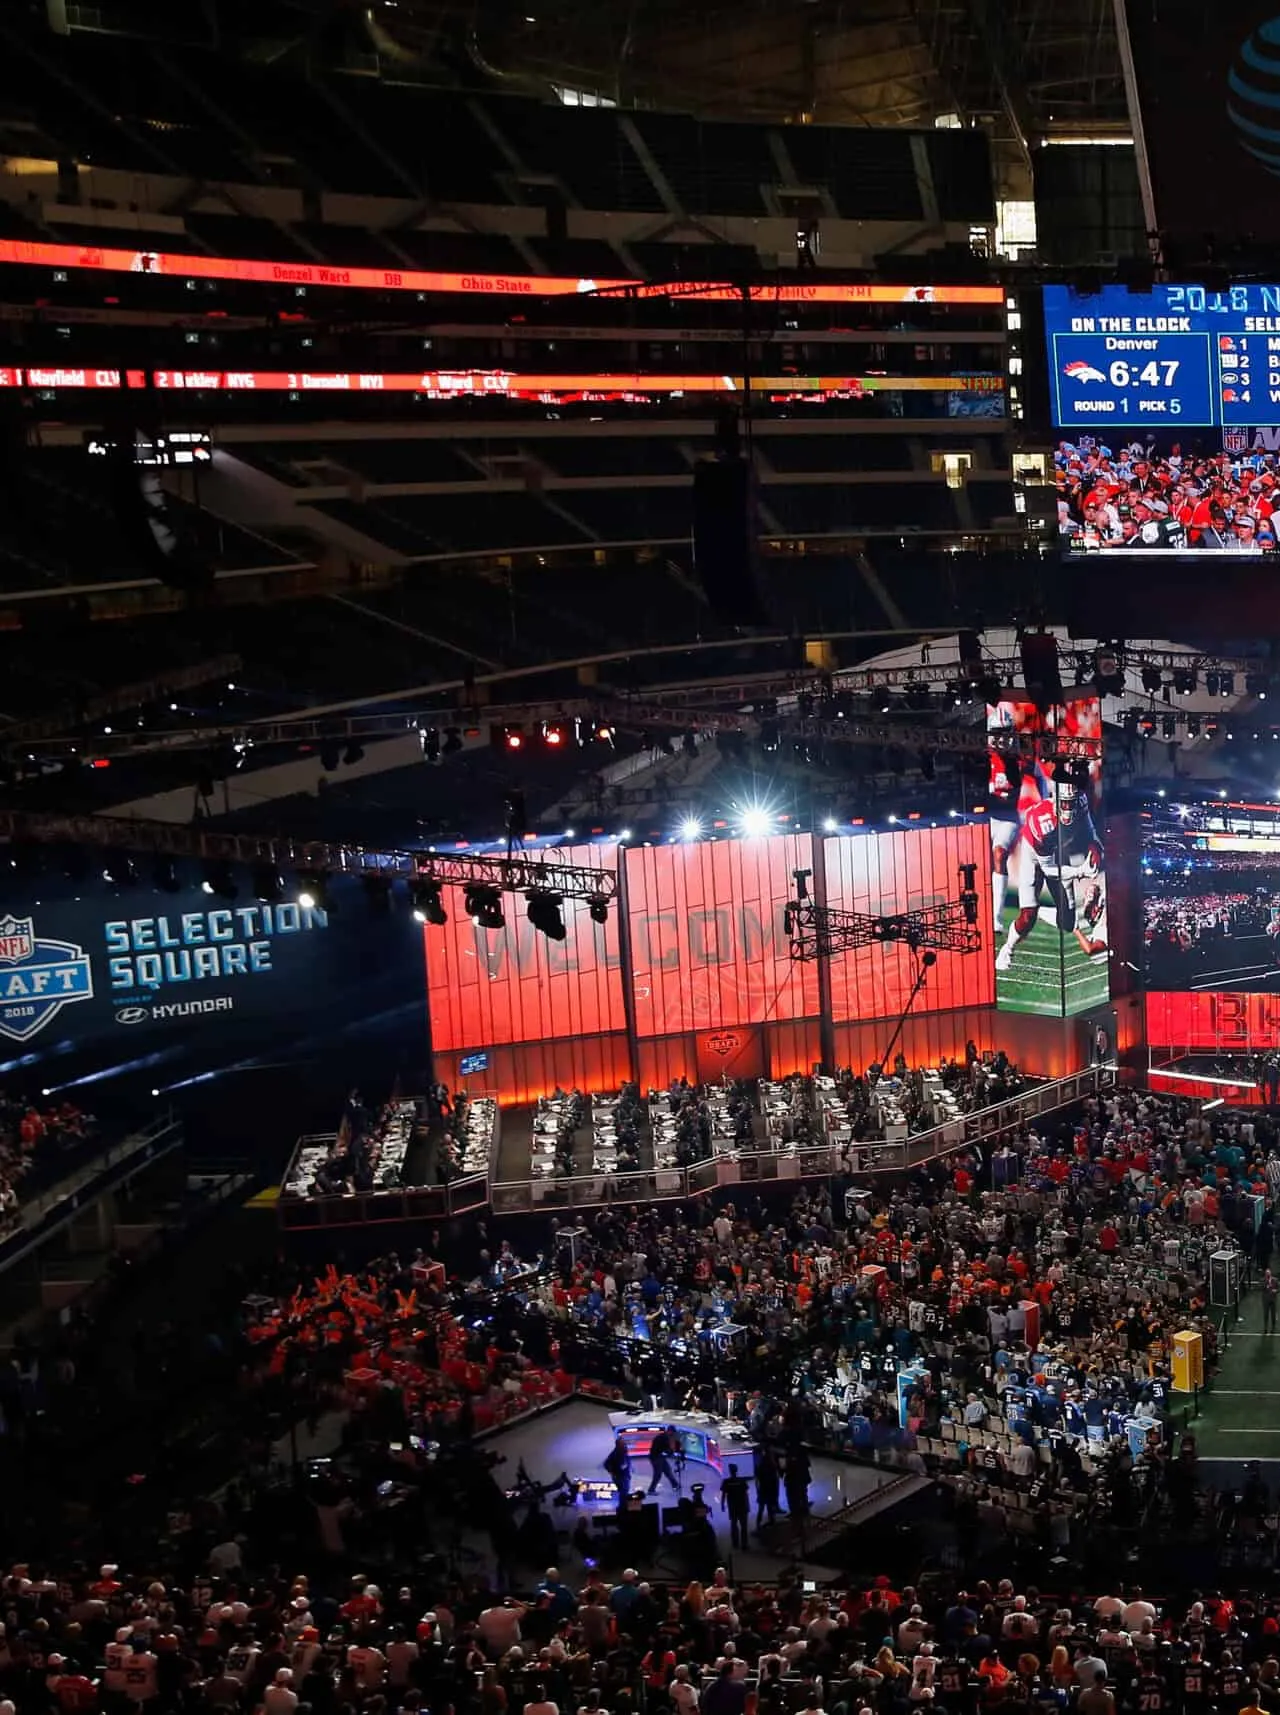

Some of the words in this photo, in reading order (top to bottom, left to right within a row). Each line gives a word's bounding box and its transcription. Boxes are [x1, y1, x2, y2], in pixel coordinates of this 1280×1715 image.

[273, 266, 313, 281] Denzel
[319, 269, 350, 283] Ward
[384, 273, 402, 286] DB
[461, 278, 493, 290] Ohio
[496, 279, 532, 292] State
[1167, 286, 1248, 313] 2018
[1071, 317, 1095, 332] ON
[1099, 317, 1131, 332] THE
[1136, 317, 1191, 332] CLOCK
[1106, 337, 1158, 350] Denver
[1240, 338, 1247, 351] 1
[1239, 356, 1250, 368] 2
[30, 370, 84, 387] Mayfield
[158, 373, 168, 387] 2
[227, 373, 255, 388] NYG
[288, 374, 297, 388] 3
[437, 375, 473, 390] Ward
[1109, 360, 1180, 387] 6:47
[1240, 373, 1251, 386] 3
[1241, 390, 1251, 403] 4
[1074, 400, 1115, 412] ROUND
[1120, 398, 1129, 414] 1
[1139, 400, 1167, 412] PICK
[1169, 398, 1182, 415] 5
[105, 902, 329, 953] SELECTION
[109, 940, 273, 990] SQUARE
[4, 1006, 36, 1018] 2018
[152, 996, 234, 1019] HYUNDAI
[819, 1262, 829, 1273] 14
[883, 1359, 895, 1371] 44
[1152, 1386, 1164, 1397] 31
[1184, 1676, 1203, 1693] 21
[1139, 1693, 1161, 1711] 70
